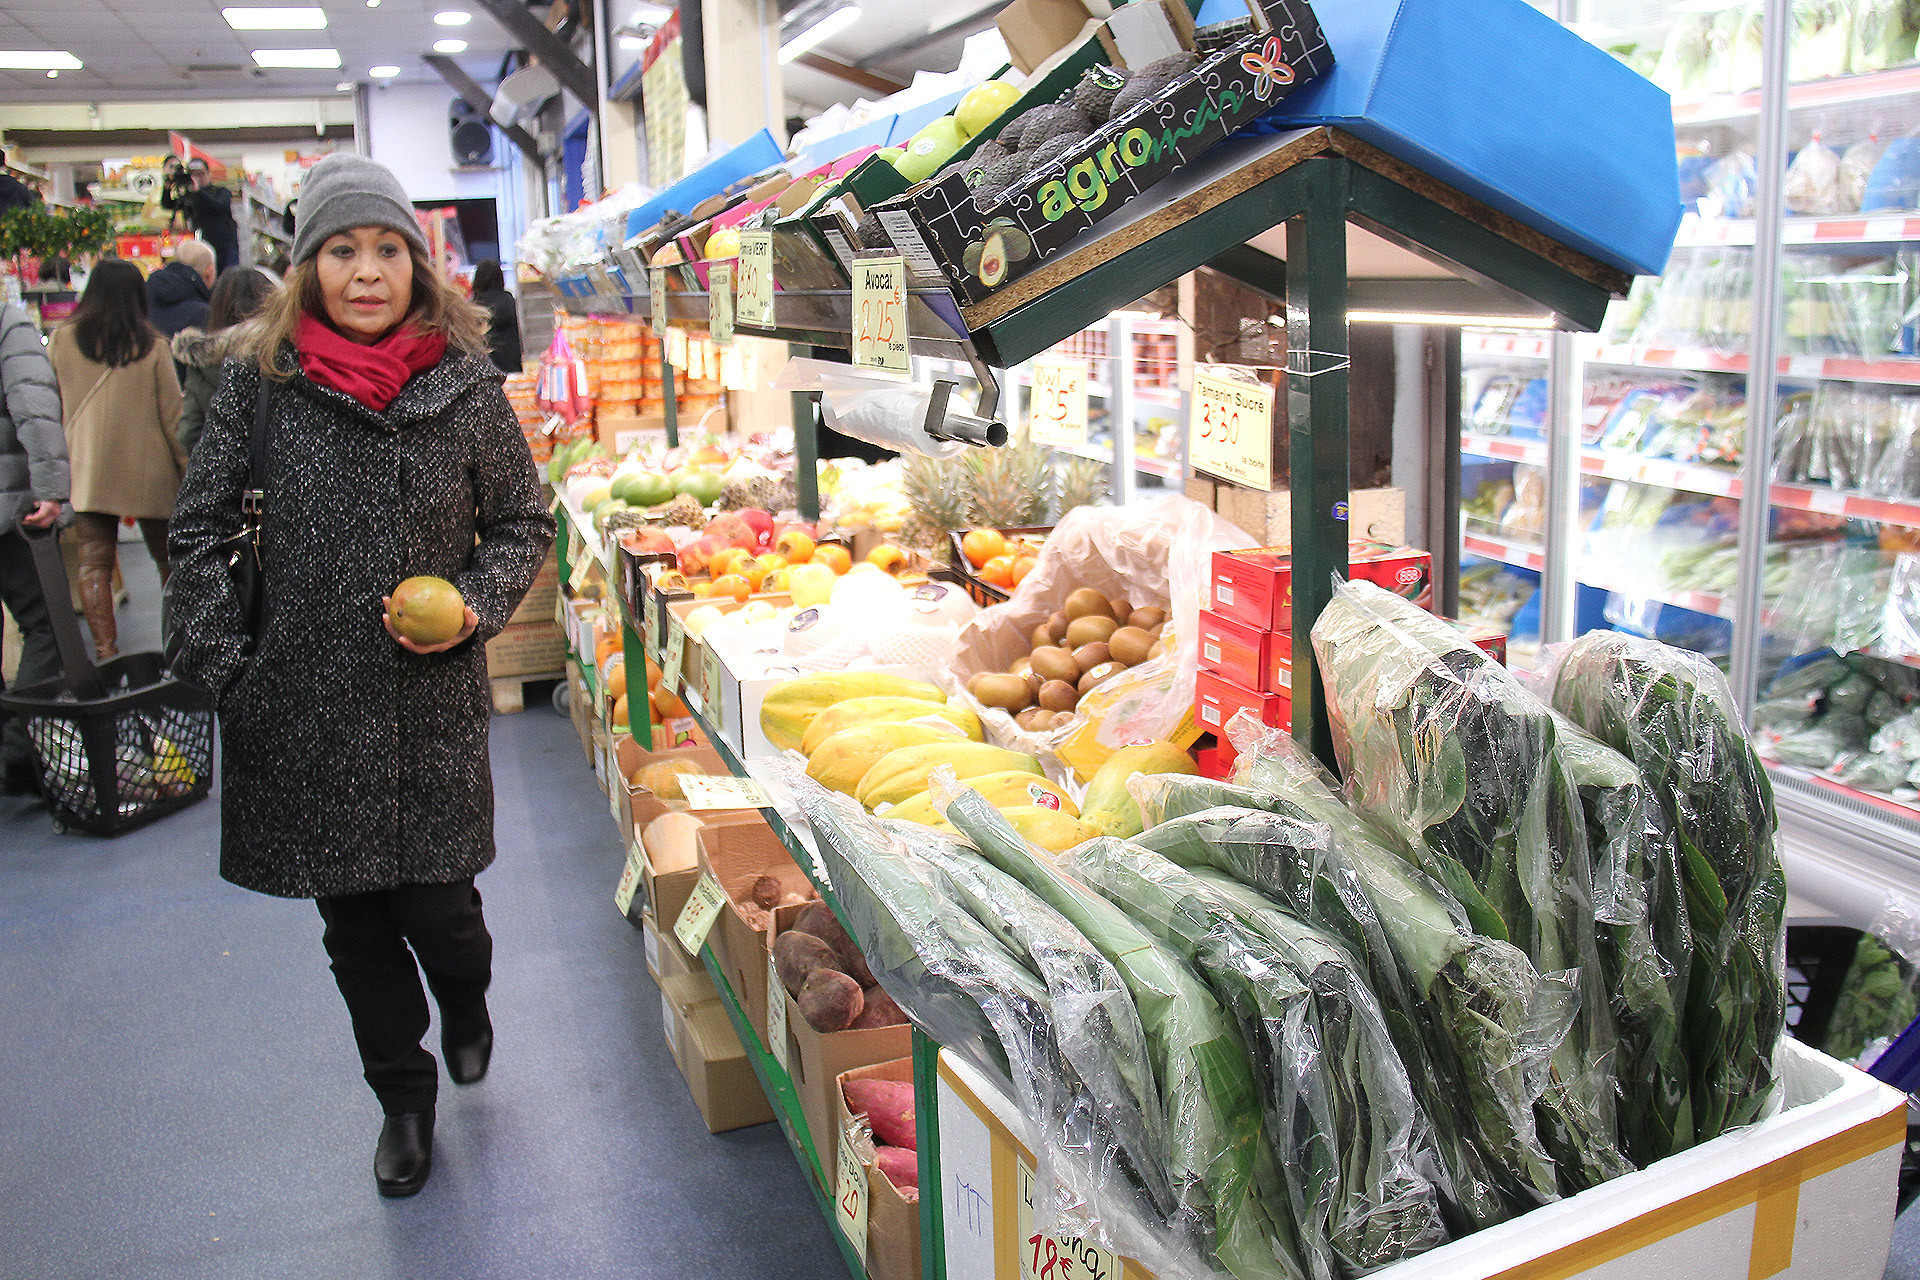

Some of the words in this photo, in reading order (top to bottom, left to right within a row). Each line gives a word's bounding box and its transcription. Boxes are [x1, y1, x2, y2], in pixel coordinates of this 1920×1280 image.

[1037, 90, 1247, 222] agromar
[865, 269, 893, 290] Avocat
[1197, 381, 1232, 403] Tamarin
[1234, 392, 1265, 413] Sucré
